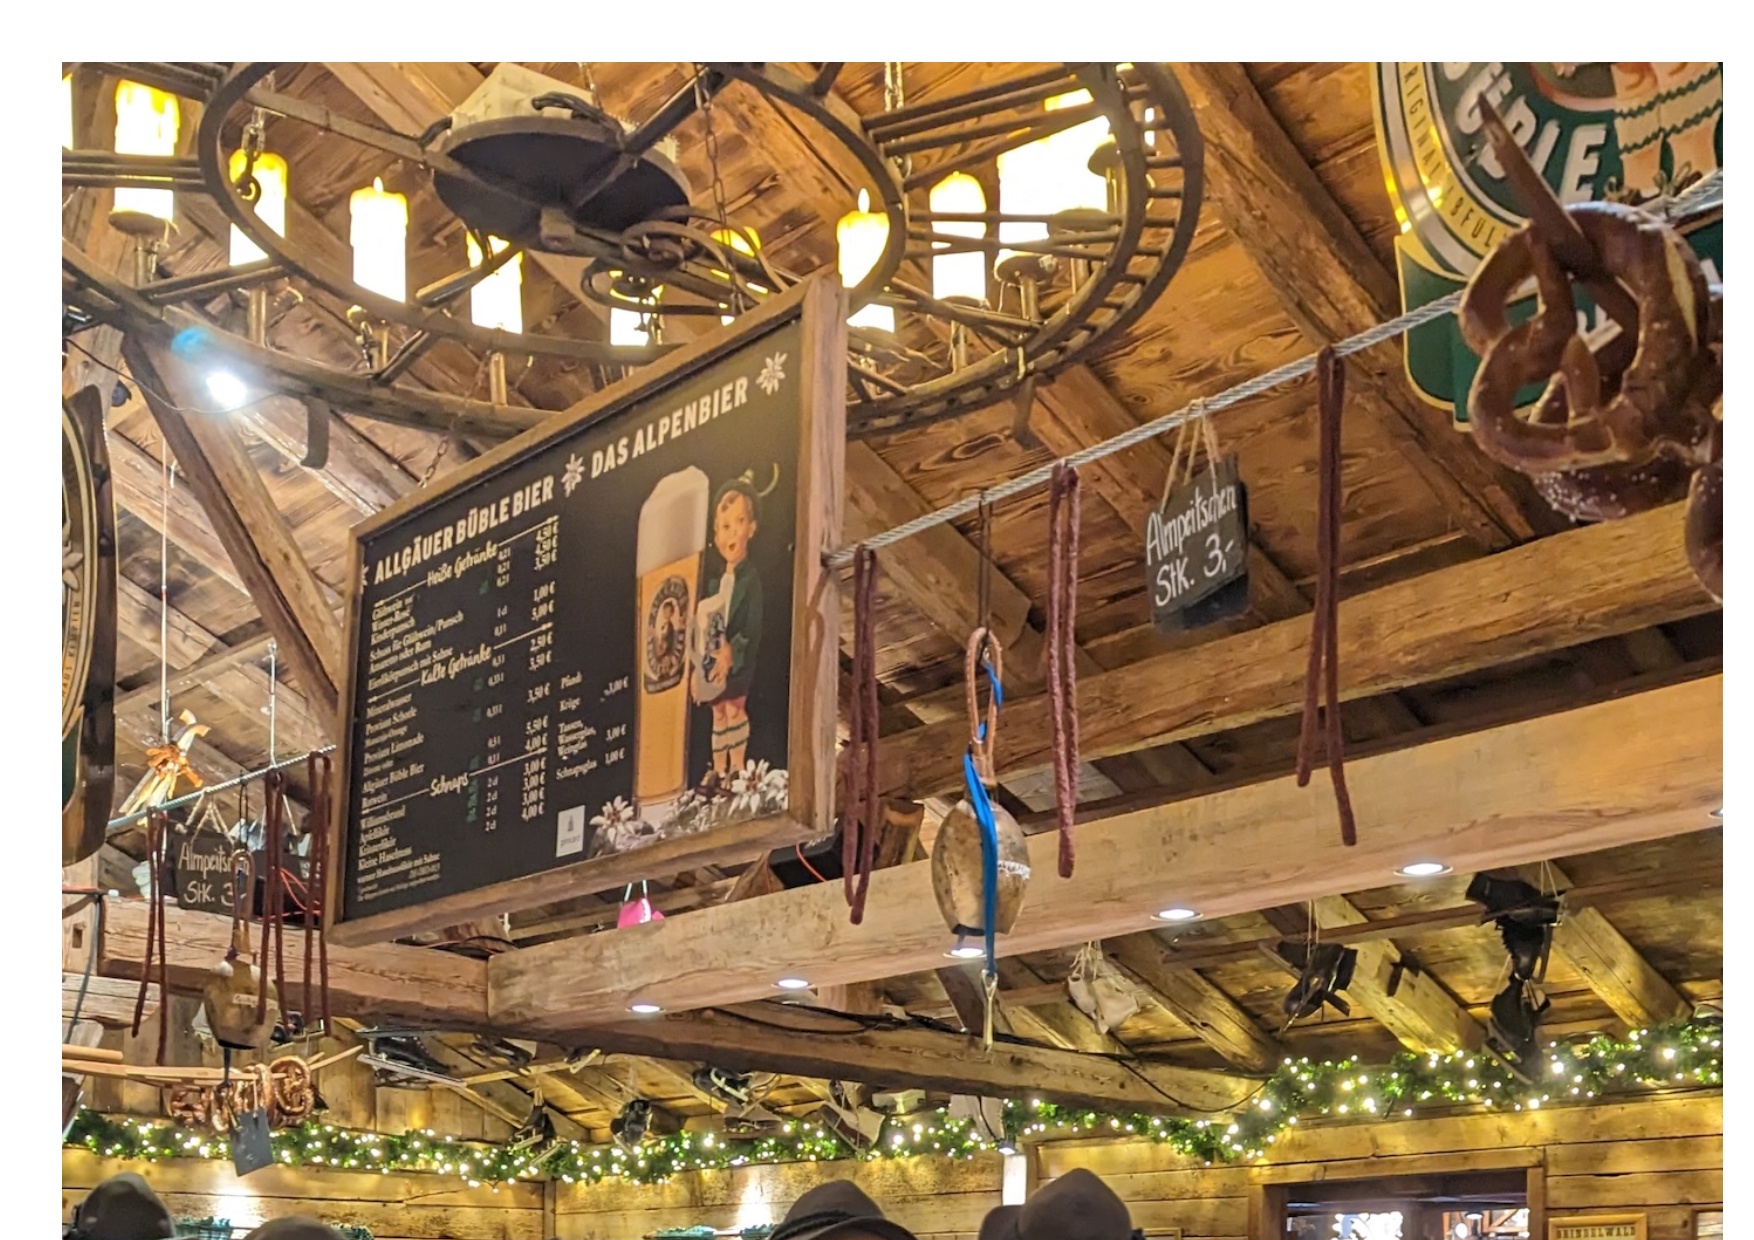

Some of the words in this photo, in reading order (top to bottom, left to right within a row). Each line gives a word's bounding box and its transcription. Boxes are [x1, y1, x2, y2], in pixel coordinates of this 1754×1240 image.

[374, 525, 453, 585] ALLGÄUER
[454, 500, 509, 546] BÜBLE
[511, 475, 555, 519] BIER
[590, 443, 629, 480] DAS
[631, 377, 749, 458] ALPENBIER
[427, 563, 452, 586] Heiße
[454, 540, 498, 578] Getränke
[421, 663, 446, 686] Kalte
[448, 643, 491, 679] Getränke
[430, 772, 468, 796] Schnaps
